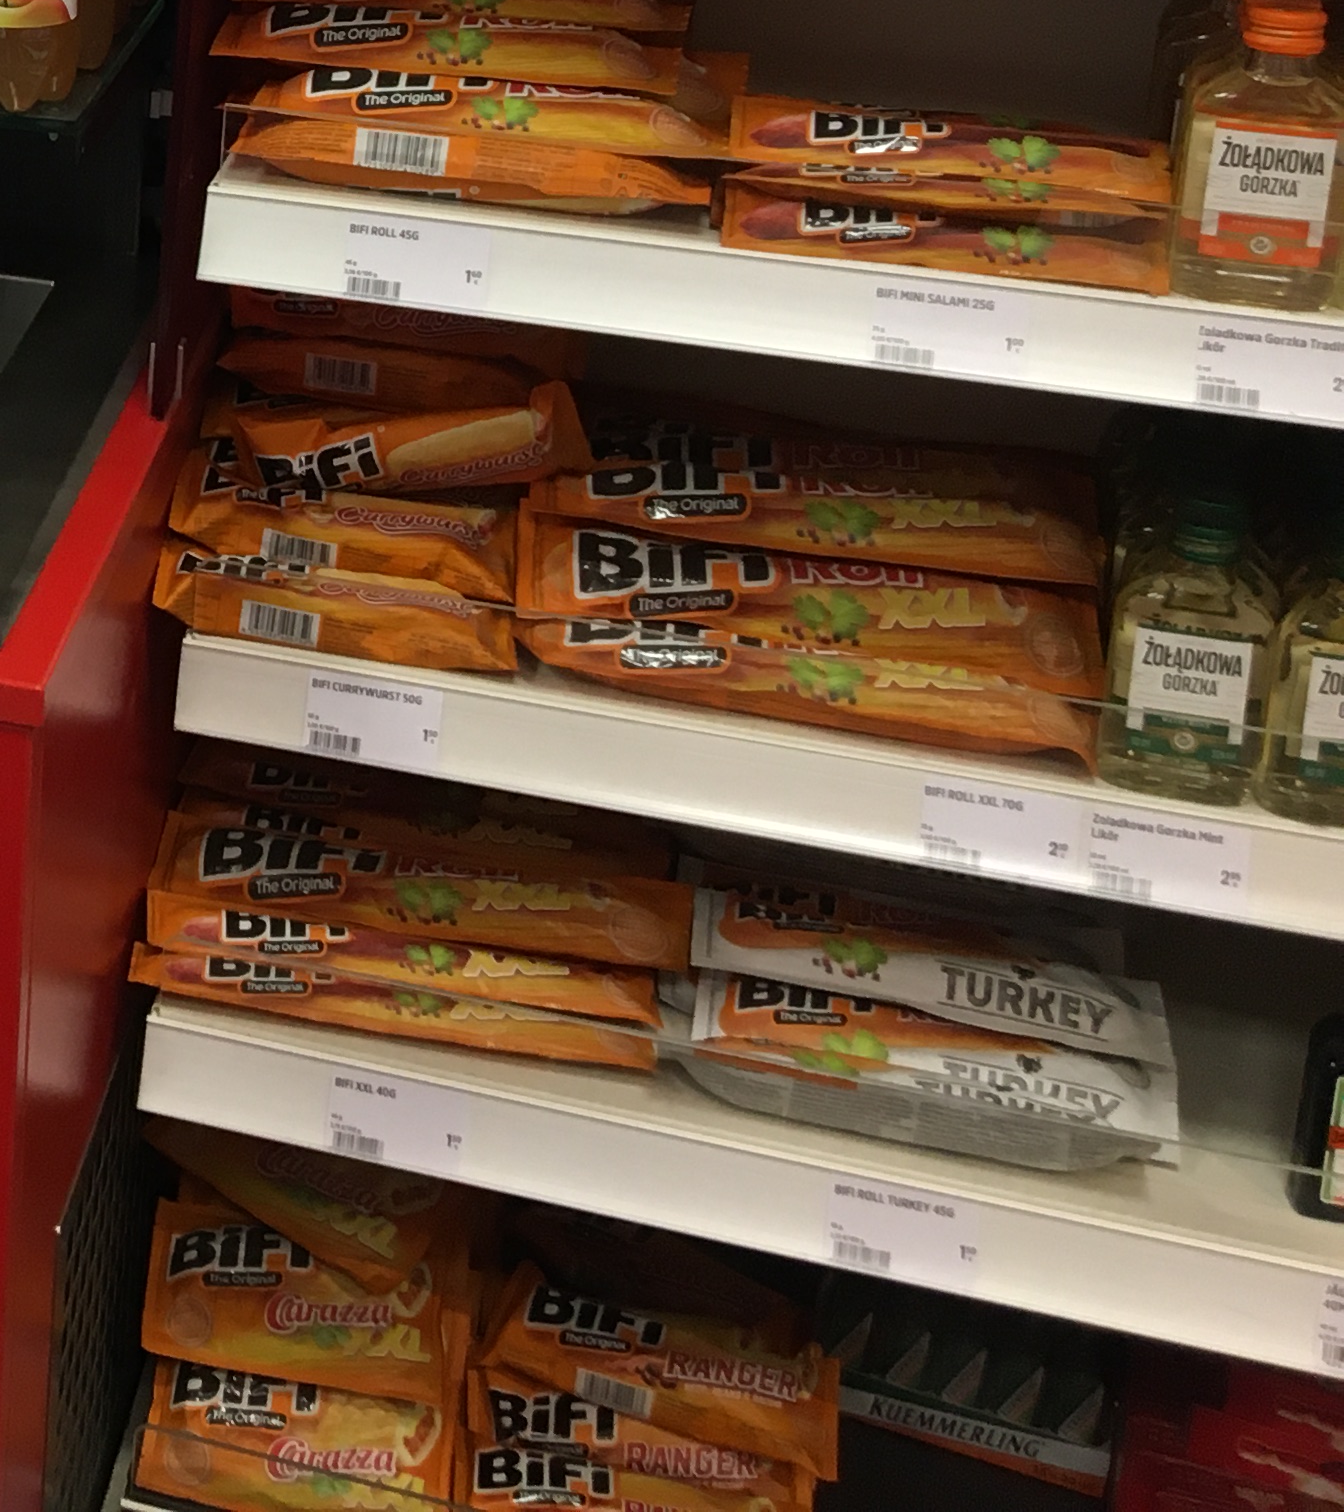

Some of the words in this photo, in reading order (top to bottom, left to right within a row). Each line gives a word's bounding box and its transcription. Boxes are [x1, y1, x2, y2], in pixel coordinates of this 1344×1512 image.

[322, 28, 346, 42] The
[349, 24, 402, 43] Original
[365, 94, 387, 105] The
[390, 91, 446, 107] Original
[1239, 174, 1298, 198] GORZKA
[350, 223, 368, 236] BIFI
[372, 225, 395, 239] ROLL
[927, 292, 970, 308] SALAMI
[1162, 672, 1219, 698] GORZKA
[940, 963, 1114, 1036] TURKEY
[266, 1290, 392, 1334] Carazza
[664, 1350, 798, 1403] RANGER
[869, 1395, 1040, 1459] KUEMMERLING
[266, 1436, 396, 1482] Carazza
[624, 1442, 758, 1478] RANGER
